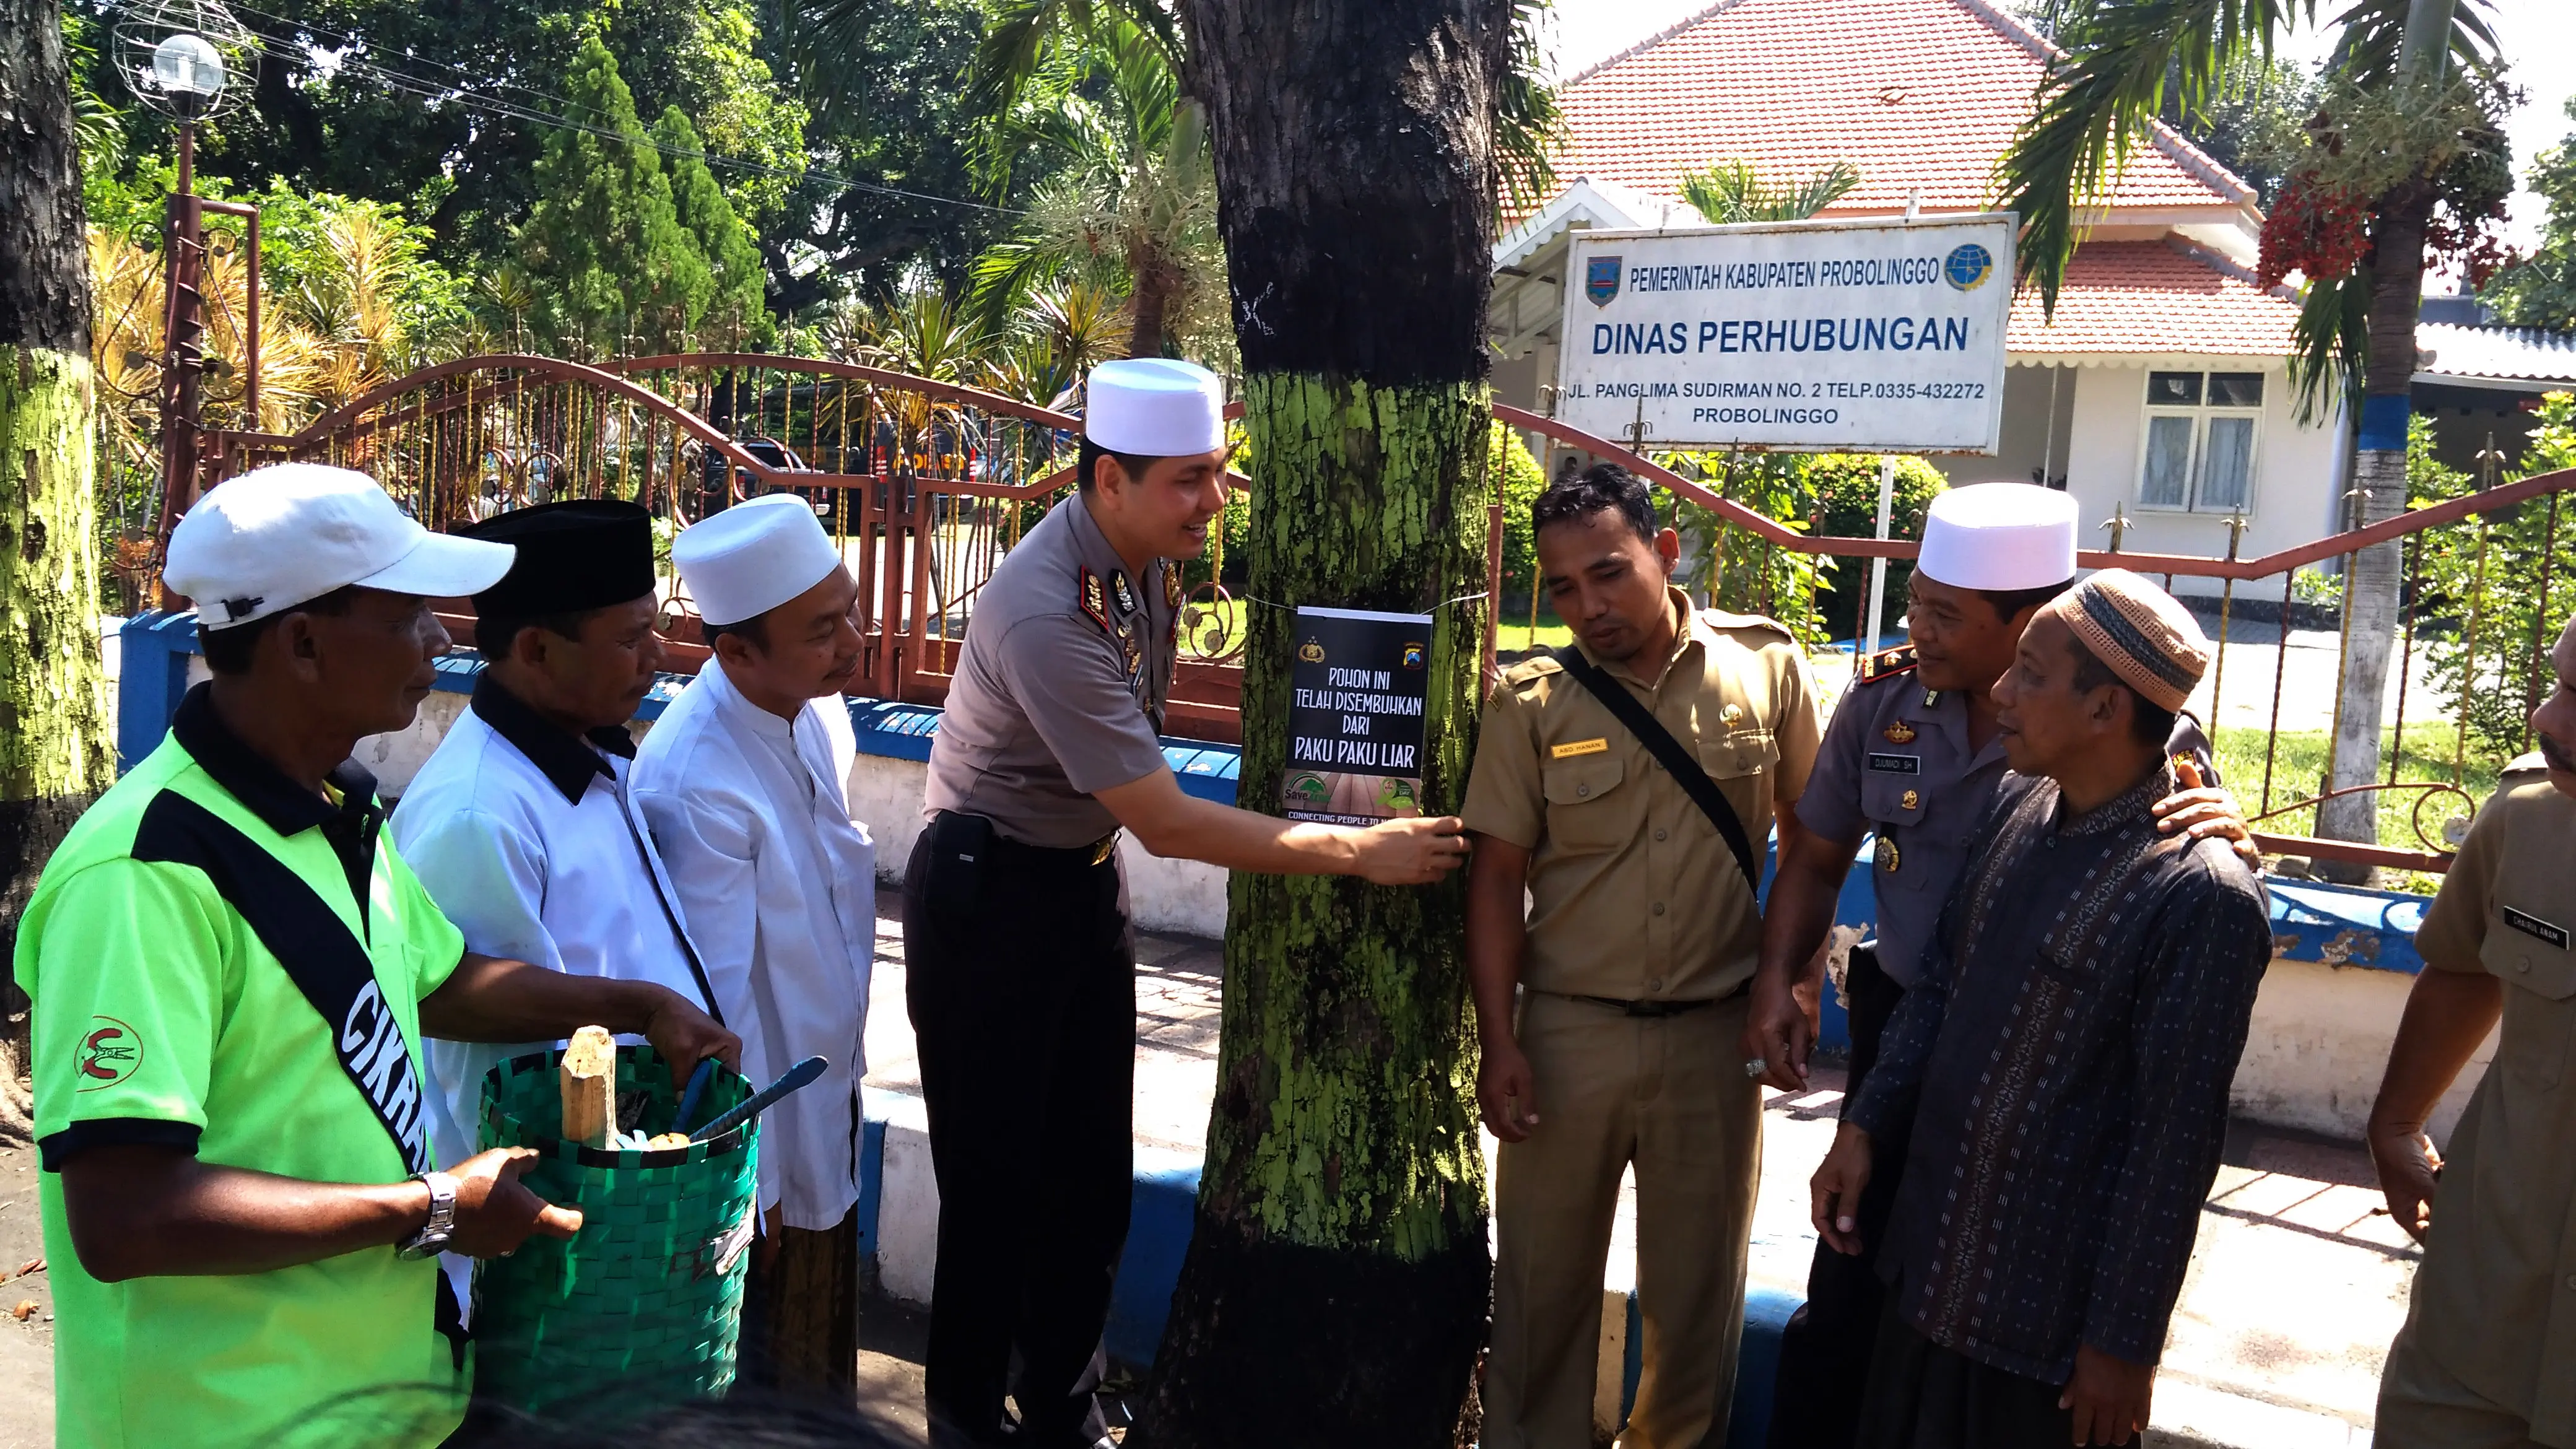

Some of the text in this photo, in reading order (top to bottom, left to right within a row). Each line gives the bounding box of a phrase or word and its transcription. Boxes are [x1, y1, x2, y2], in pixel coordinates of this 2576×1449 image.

[1630, 257, 1939, 292] PEMERINTAH KABUPATEN PROBOLINGGO
[1593, 316, 1969, 355] DINAS PERHUBUNGAN
[1568, 382, 1985, 399] JL. PANGLIMA SUDIRMAN NO. 2 TELP.0335-432272
[1693, 407, 1838, 425] PROBOLINGGO
[1328, 667, 1391, 690] POHON INI
[1295, 688, 1422, 716] TELAH DISEMBUHKAN
[1342, 715, 1370, 736] DARI
[1294, 736, 1415, 768] PAKU PAKU LIAR
[1284, 788, 1308, 801] Save
[1288, 811, 1335, 822] CONNECTING
[1338, 816, 1367, 825] PEOPLE
